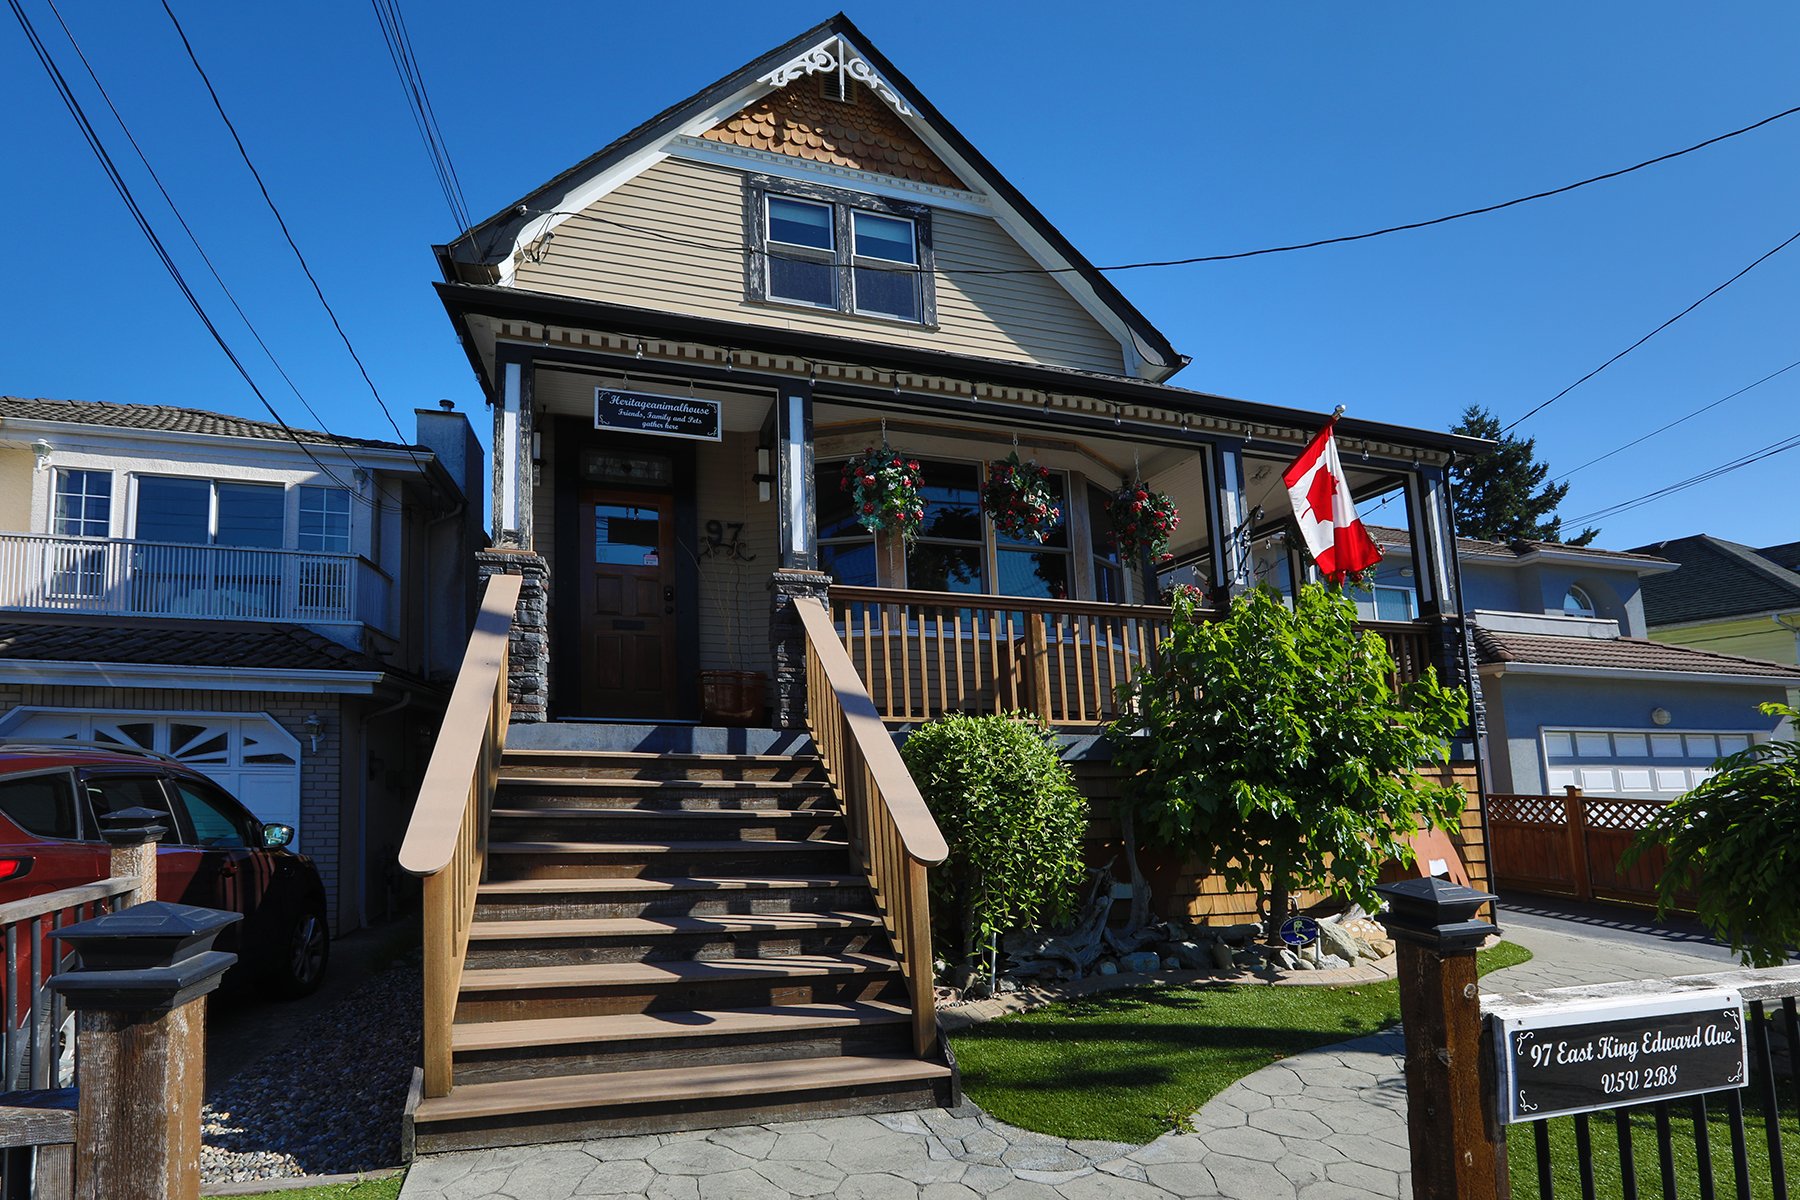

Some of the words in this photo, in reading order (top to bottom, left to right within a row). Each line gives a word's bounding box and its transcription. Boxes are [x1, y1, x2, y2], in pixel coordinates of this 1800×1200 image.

[609, 394, 709, 415] Heritageanimalhouse
[618, 408, 646, 419] Friends,
[647, 411, 671, 422] Family
[672, 415, 686, 423] and
[687, 416, 703, 425] Pets
[641, 421, 663, 429] gather
[664, 423, 679, 431] here
[705, 519, 744, 545] 97
[1530, 1043, 1552, 1068] 97
[1556, 1041, 1594, 1065] East
[1597, 1036, 1639, 1063] King
[1641, 1027, 1702, 1054] Edward
[1704, 1024, 1736, 1045] Ave.
[1601, 1070, 1640, 1094] V5V
[1643, 1064, 1678, 1090] 2B8
